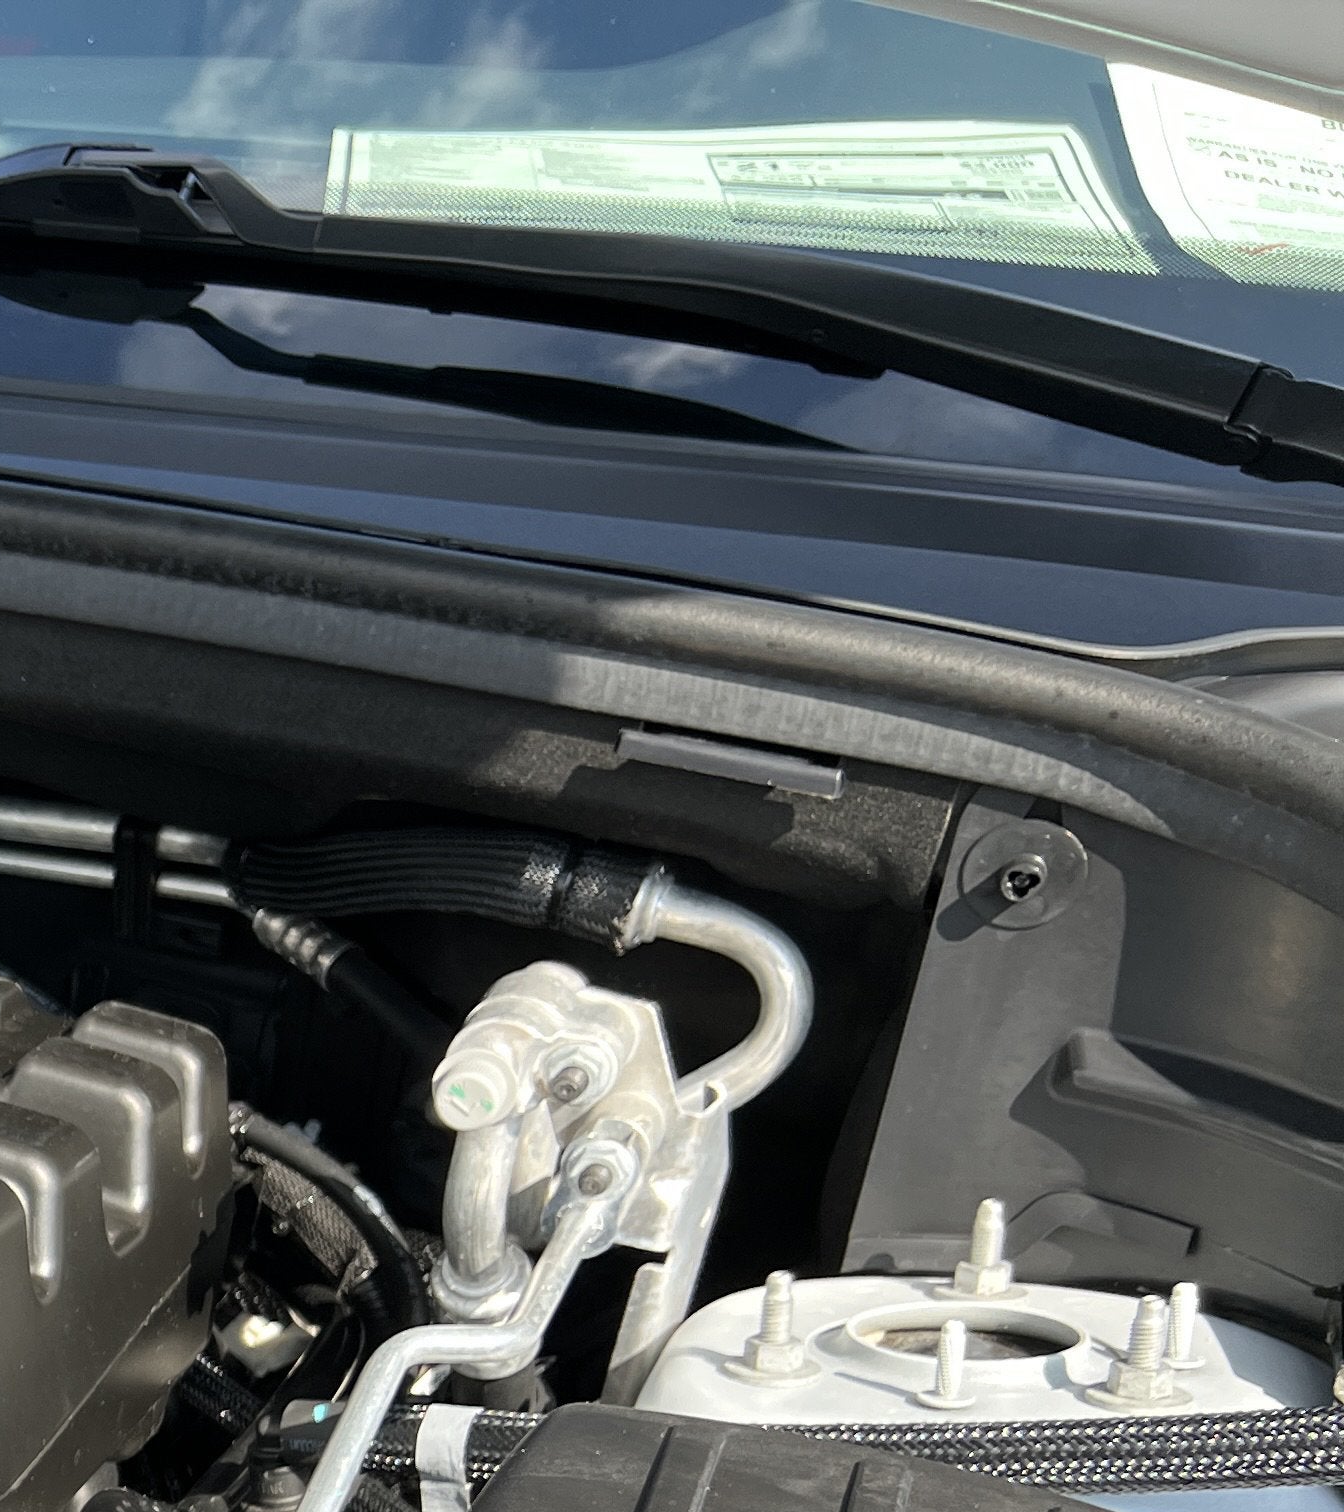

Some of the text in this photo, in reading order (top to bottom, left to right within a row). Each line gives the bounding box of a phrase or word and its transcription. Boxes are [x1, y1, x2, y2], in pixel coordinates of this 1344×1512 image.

[1218, 150, 1250, 163] AS
[1256, 157, 1278, 169] IS
[1299, 165, 1334, 179] NO
[1224, 169, 1321, 195] DEALER
